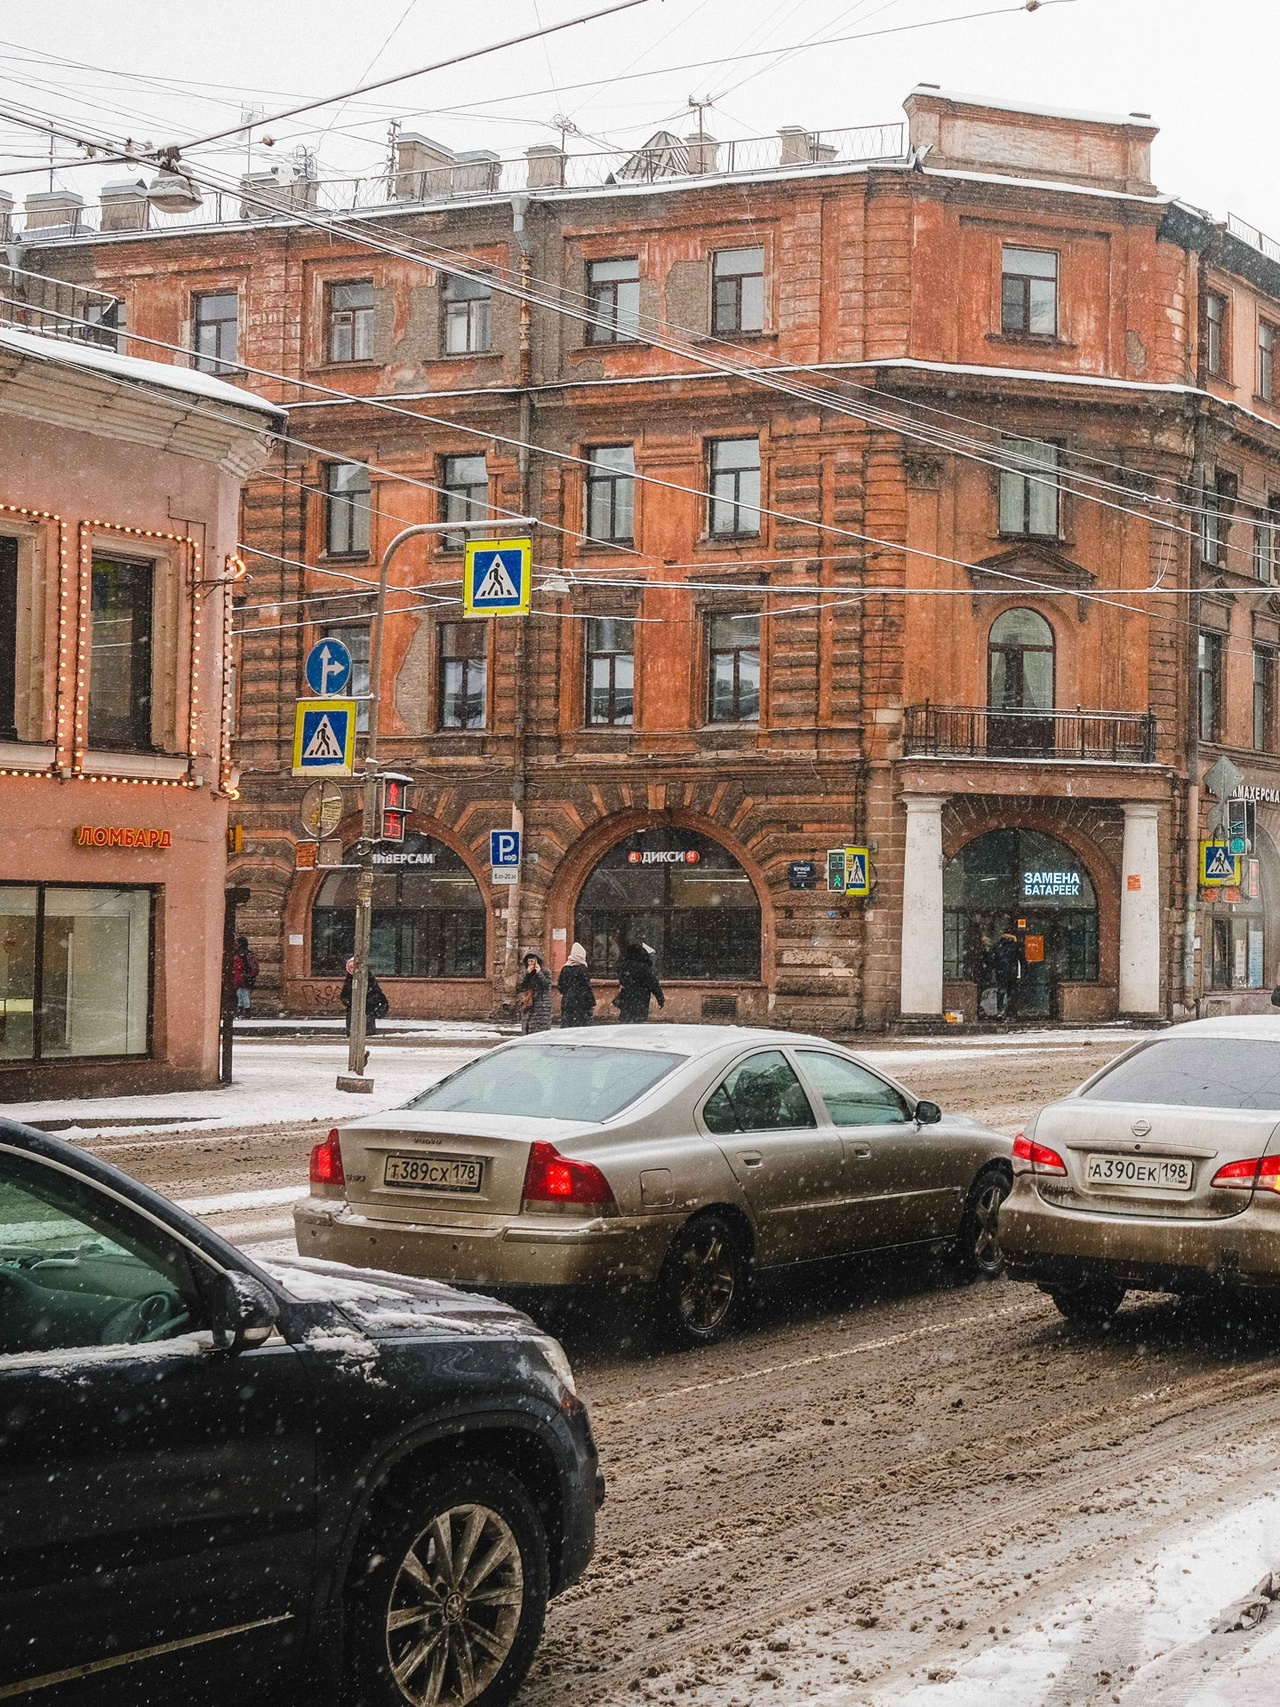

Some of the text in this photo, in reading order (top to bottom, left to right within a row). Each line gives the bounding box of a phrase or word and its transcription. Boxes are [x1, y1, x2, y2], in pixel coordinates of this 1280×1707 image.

[79, 825, 172, 848] ЛОМБАРД
[499, 835, 515, 862] P
[372, 853, 435, 864] НИВЕРСАМ
[642, 851, 685, 864] ДИКСИ
[1024, 872, 1080, 884] ЗАМЕНА
[1024, 885, 1079, 895] БАТАРЕЕК
[391, 1160, 476, 1182] Т389СХ 178
[1092, 1160, 1186, 1181] А390ЕК 198
